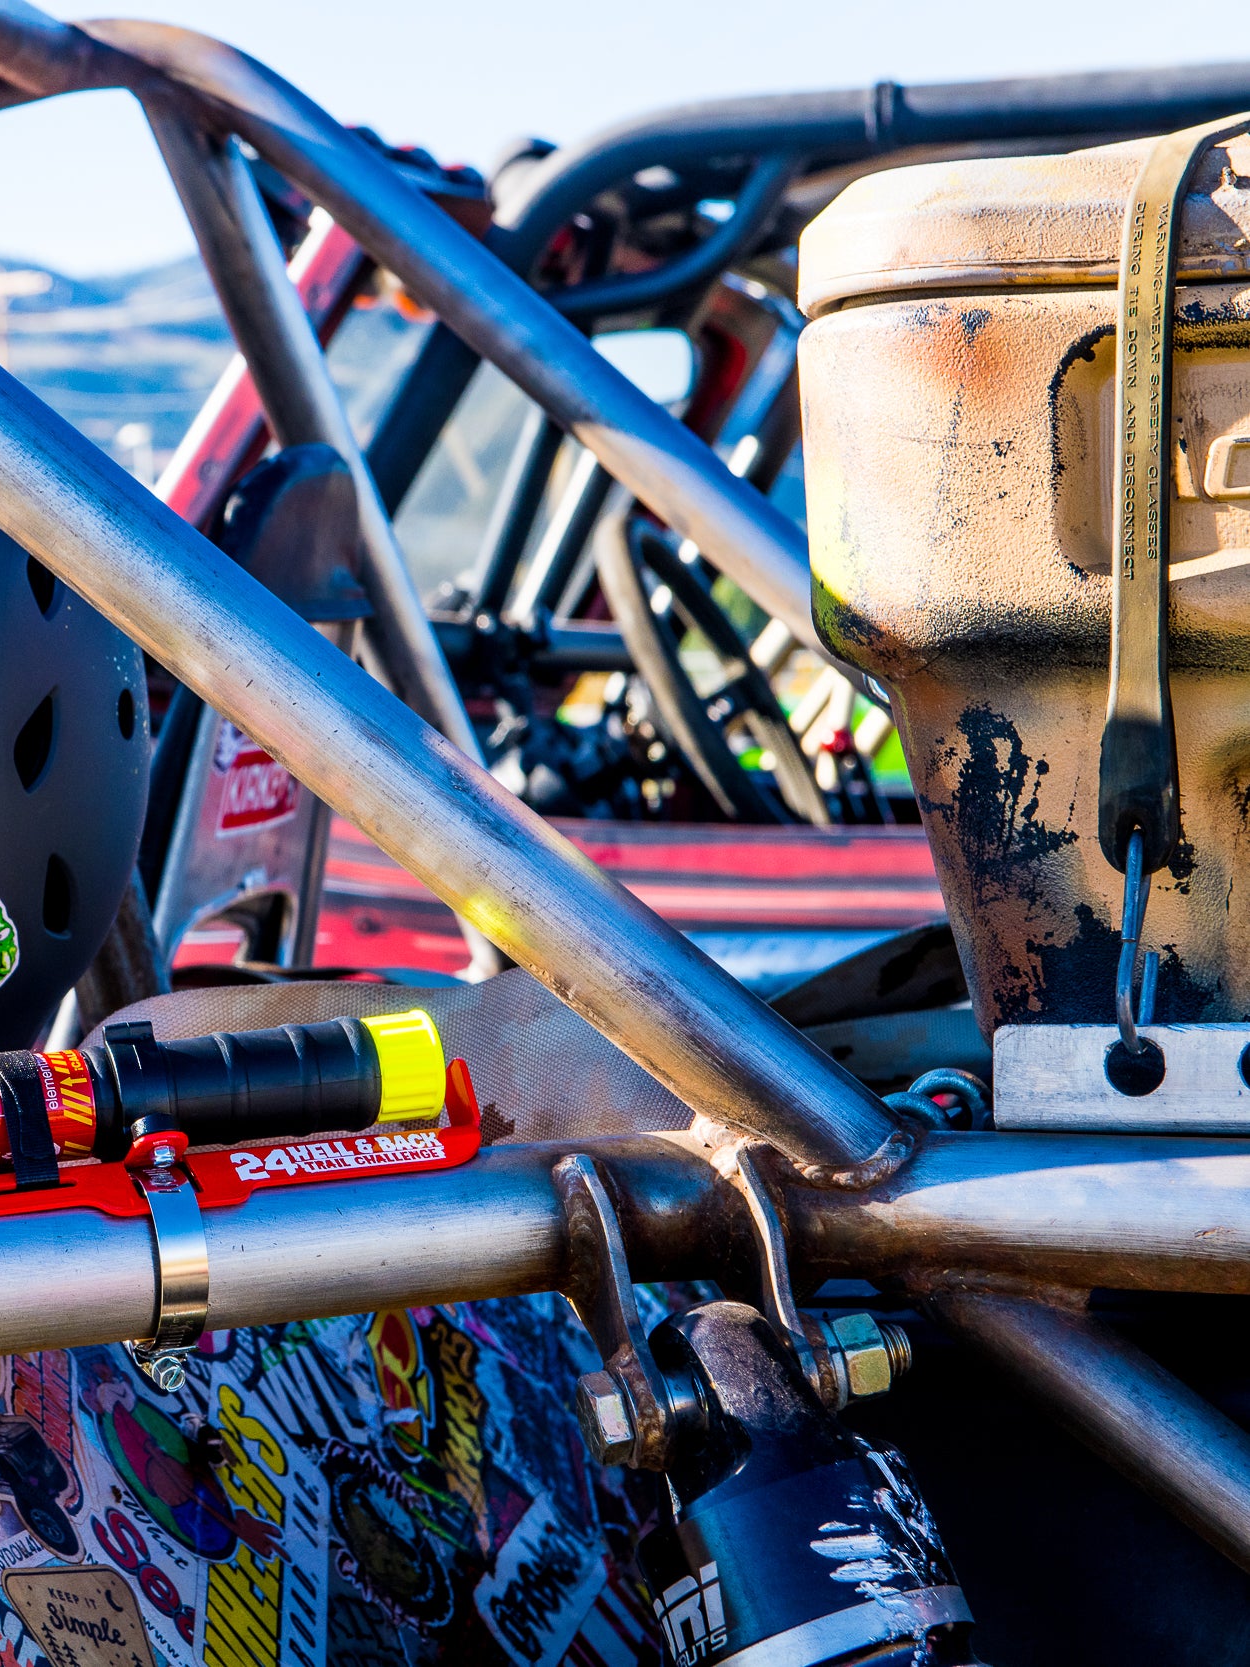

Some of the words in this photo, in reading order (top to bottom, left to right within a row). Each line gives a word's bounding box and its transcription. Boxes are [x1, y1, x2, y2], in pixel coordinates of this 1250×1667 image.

[1130, 200, 1147, 275] DURING
[1128, 284, 1139, 316] TIE
[1126, 326, 1138, 389] DOWN
[1125, 399, 1136, 443] AND
[1148, 373, 1161, 457] SAFETY
[1122, 452, 1135, 581] DISCONNECT
[1146, 464, 1158, 560] GLASSES
[230, 1148, 298, 1182] 24
[291, 1142, 352, 1163] HELL
[354, 1136, 374, 1155] &
[375, 1131, 442, 1152] BACK
[304, 1156, 352, 1172] TRAIL
[353, 1146, 441, 1167] CHALLENGE
[47, 1587, 83, 1609] KEEP
[82, 1594, 98, 1610] IT
[49, 1604, 127, 1648] Simple
